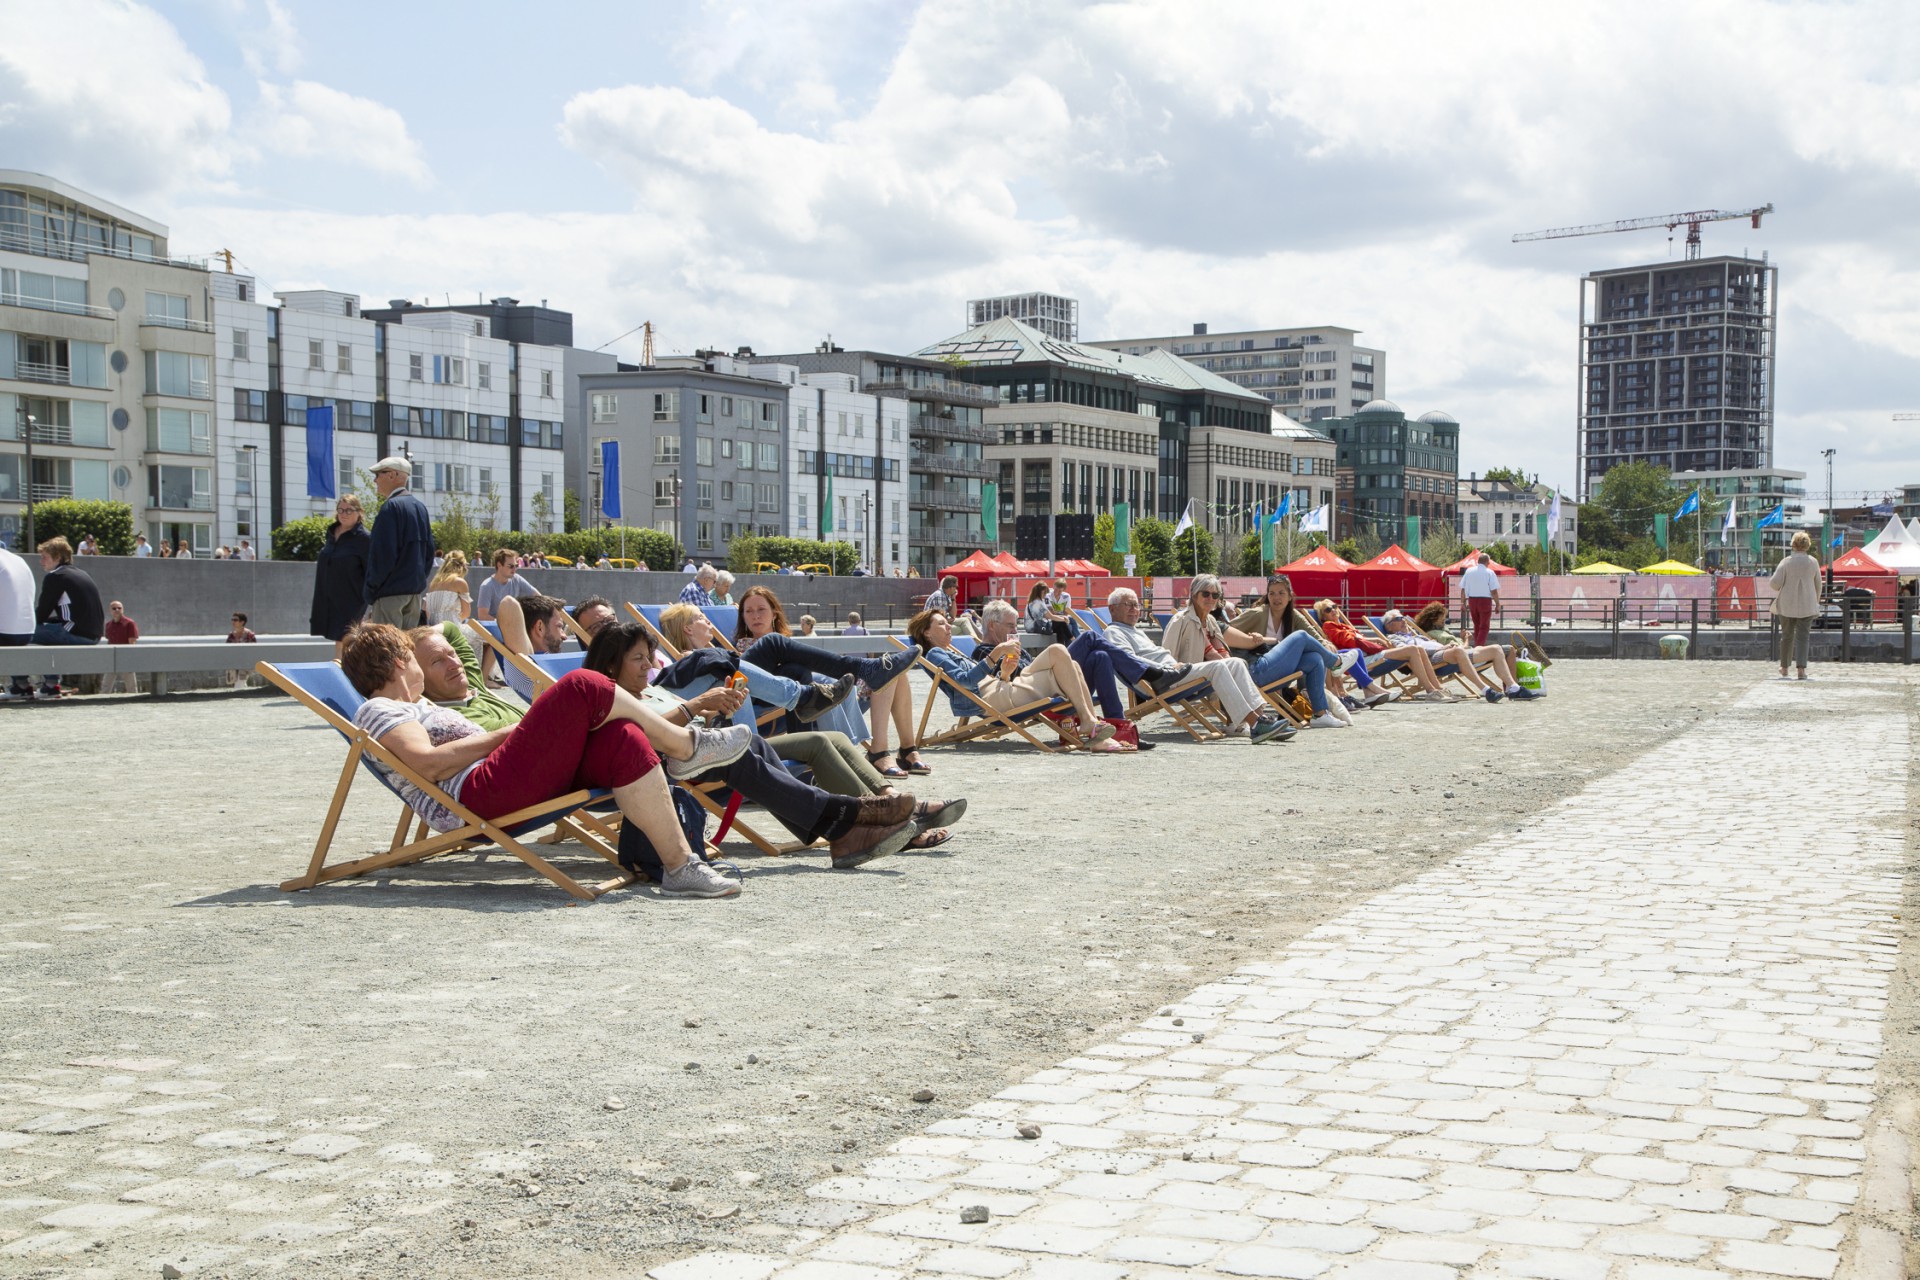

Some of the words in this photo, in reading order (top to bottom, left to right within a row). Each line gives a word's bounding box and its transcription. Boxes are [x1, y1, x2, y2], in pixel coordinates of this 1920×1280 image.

[1308, 556, 1320, 565] A
[1382, 556, 1393, 565] A
[1845, 557, 1859, 566] A
[1568, 586, 1590, 608] A
[1653, 583, 1681, 611] A
[1729, 586, 1742, 610] A
